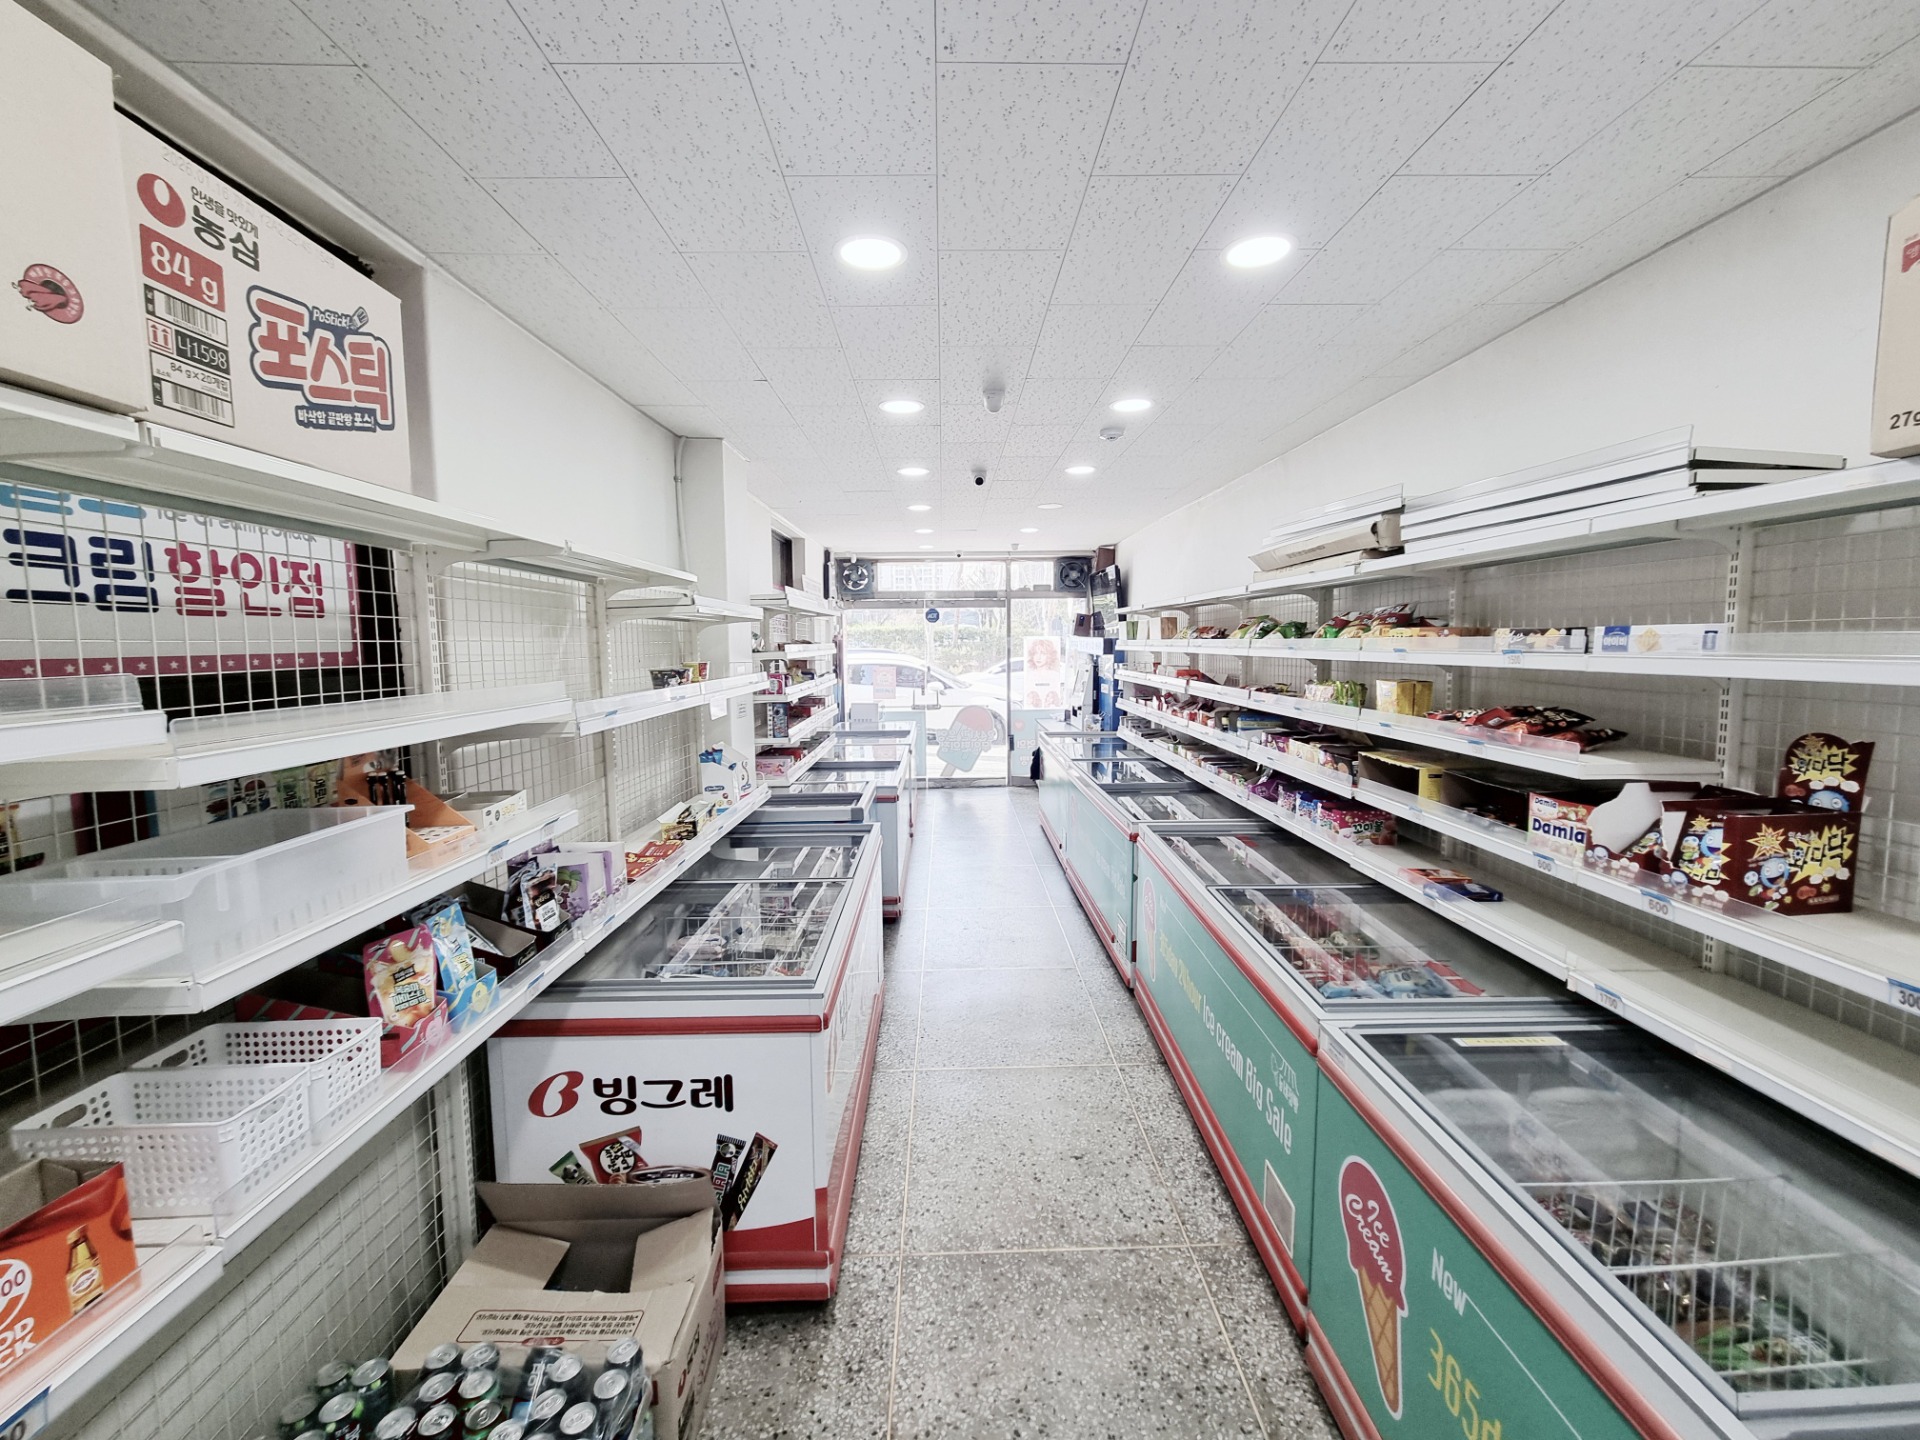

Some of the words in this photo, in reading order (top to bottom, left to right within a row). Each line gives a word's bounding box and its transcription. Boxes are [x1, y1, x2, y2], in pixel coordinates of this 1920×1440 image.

[191, 186, 225, 218] 인생을
[226, 207, 259, 239] 맛있게
[192, 205, 260, 272] 농심
[150, 241, 195, 287] 84
[177, 335, 228, 370] 나1598
[255, 298, 389, 421] 포스틱
[297, 409, 327, 425] 바삭함
[327, 412, 353, 427] 끝판왕
[1535, 797, 1558, 809] Damla
[1532, 817, 1587, 844] Damla
[593, 1073, 734, 1116] 빙그레
[1202, 994, 1215, 1037] Ice
[1216, 1021, 1244, 1082] cream
[1246, 1057, 1264, 1112] Big
[1265, 1087, 1293, 1156] Sale
[1345, 1193, 1393, 1283] Cream
[1367, 1199, 1391, 1249] Ice
[1431, 1247, 1469, 1317] New
